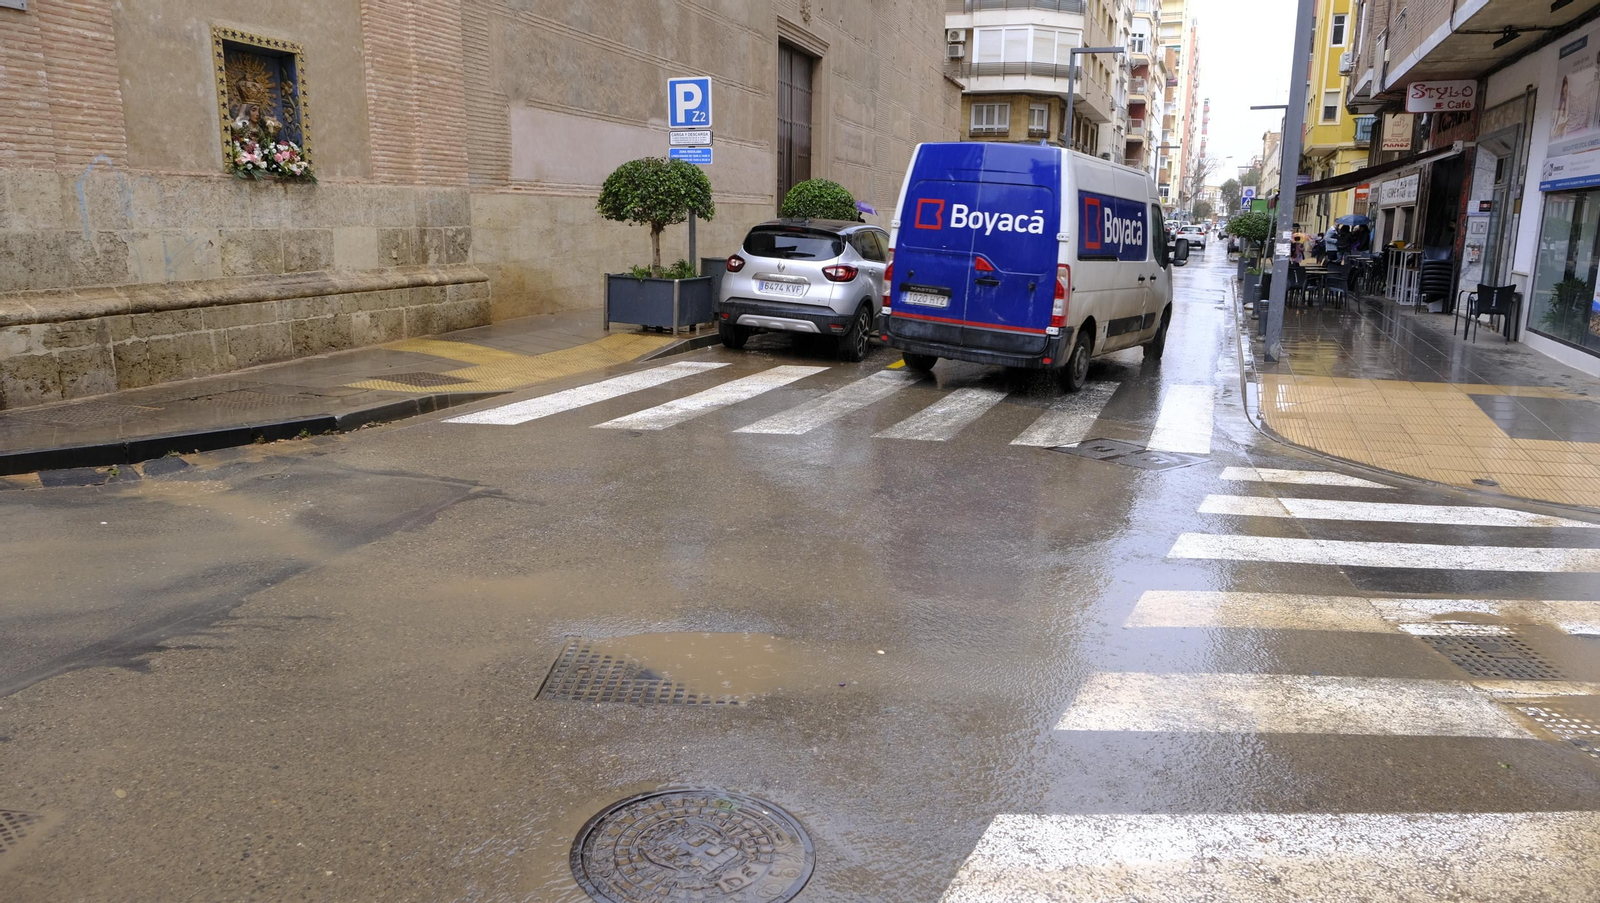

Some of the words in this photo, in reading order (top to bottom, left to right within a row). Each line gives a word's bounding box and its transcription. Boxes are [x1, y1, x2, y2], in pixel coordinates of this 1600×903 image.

[676, 83, 702, 123] P
[1447, 100, 1472, 110] Café
[692, 111, 706, 122] Z2
[764, 281, 784, 292] 6474
[785, 284, 802, 294] KVF
[910, 286, 939, 294] MASTER
[909, 292, 928, 303] 1020
[929, 295, 947, 306] HYZ
